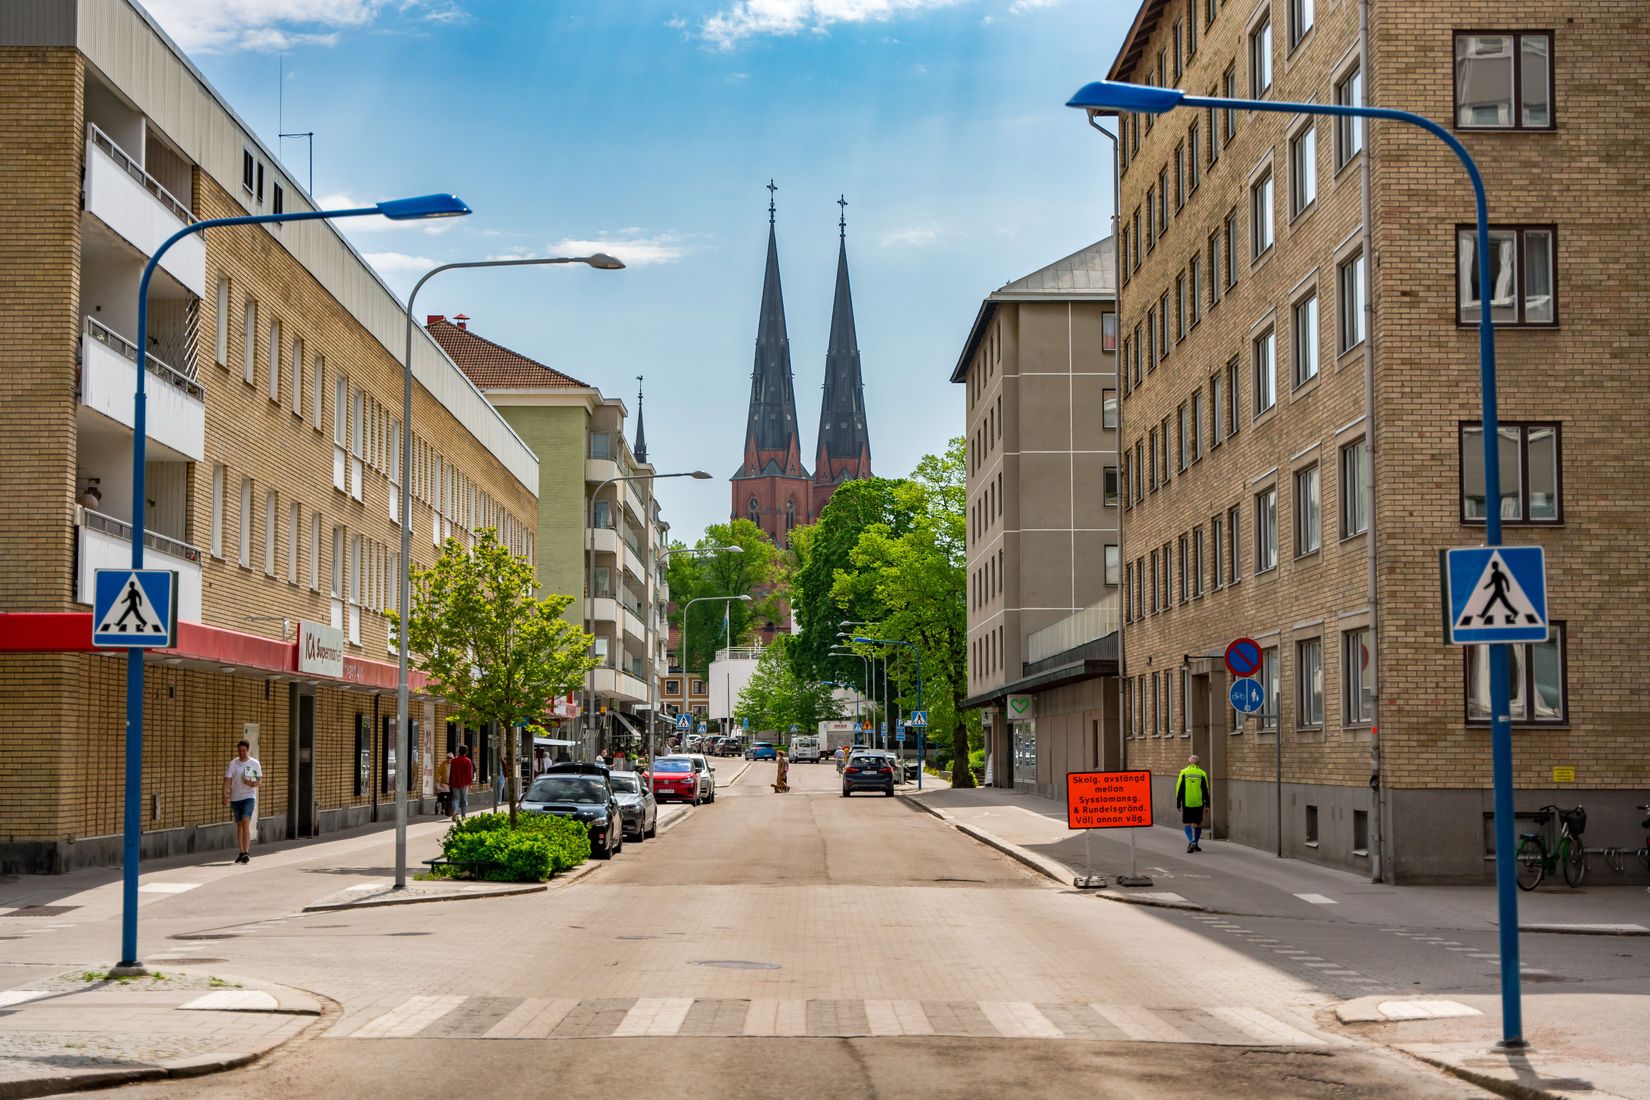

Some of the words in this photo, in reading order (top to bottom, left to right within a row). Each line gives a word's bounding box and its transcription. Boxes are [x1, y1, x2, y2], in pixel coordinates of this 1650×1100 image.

[305, 632, 316, 661] ICA
[1072, 776, 1100, 784] Skolg.
[1103, 774, 1145, 783] avstängd
[1094, 785, 1124, 793] mellan
[1075, 816, 1093, 824] Välj
[1126, 814, 1145, 823] väg.
